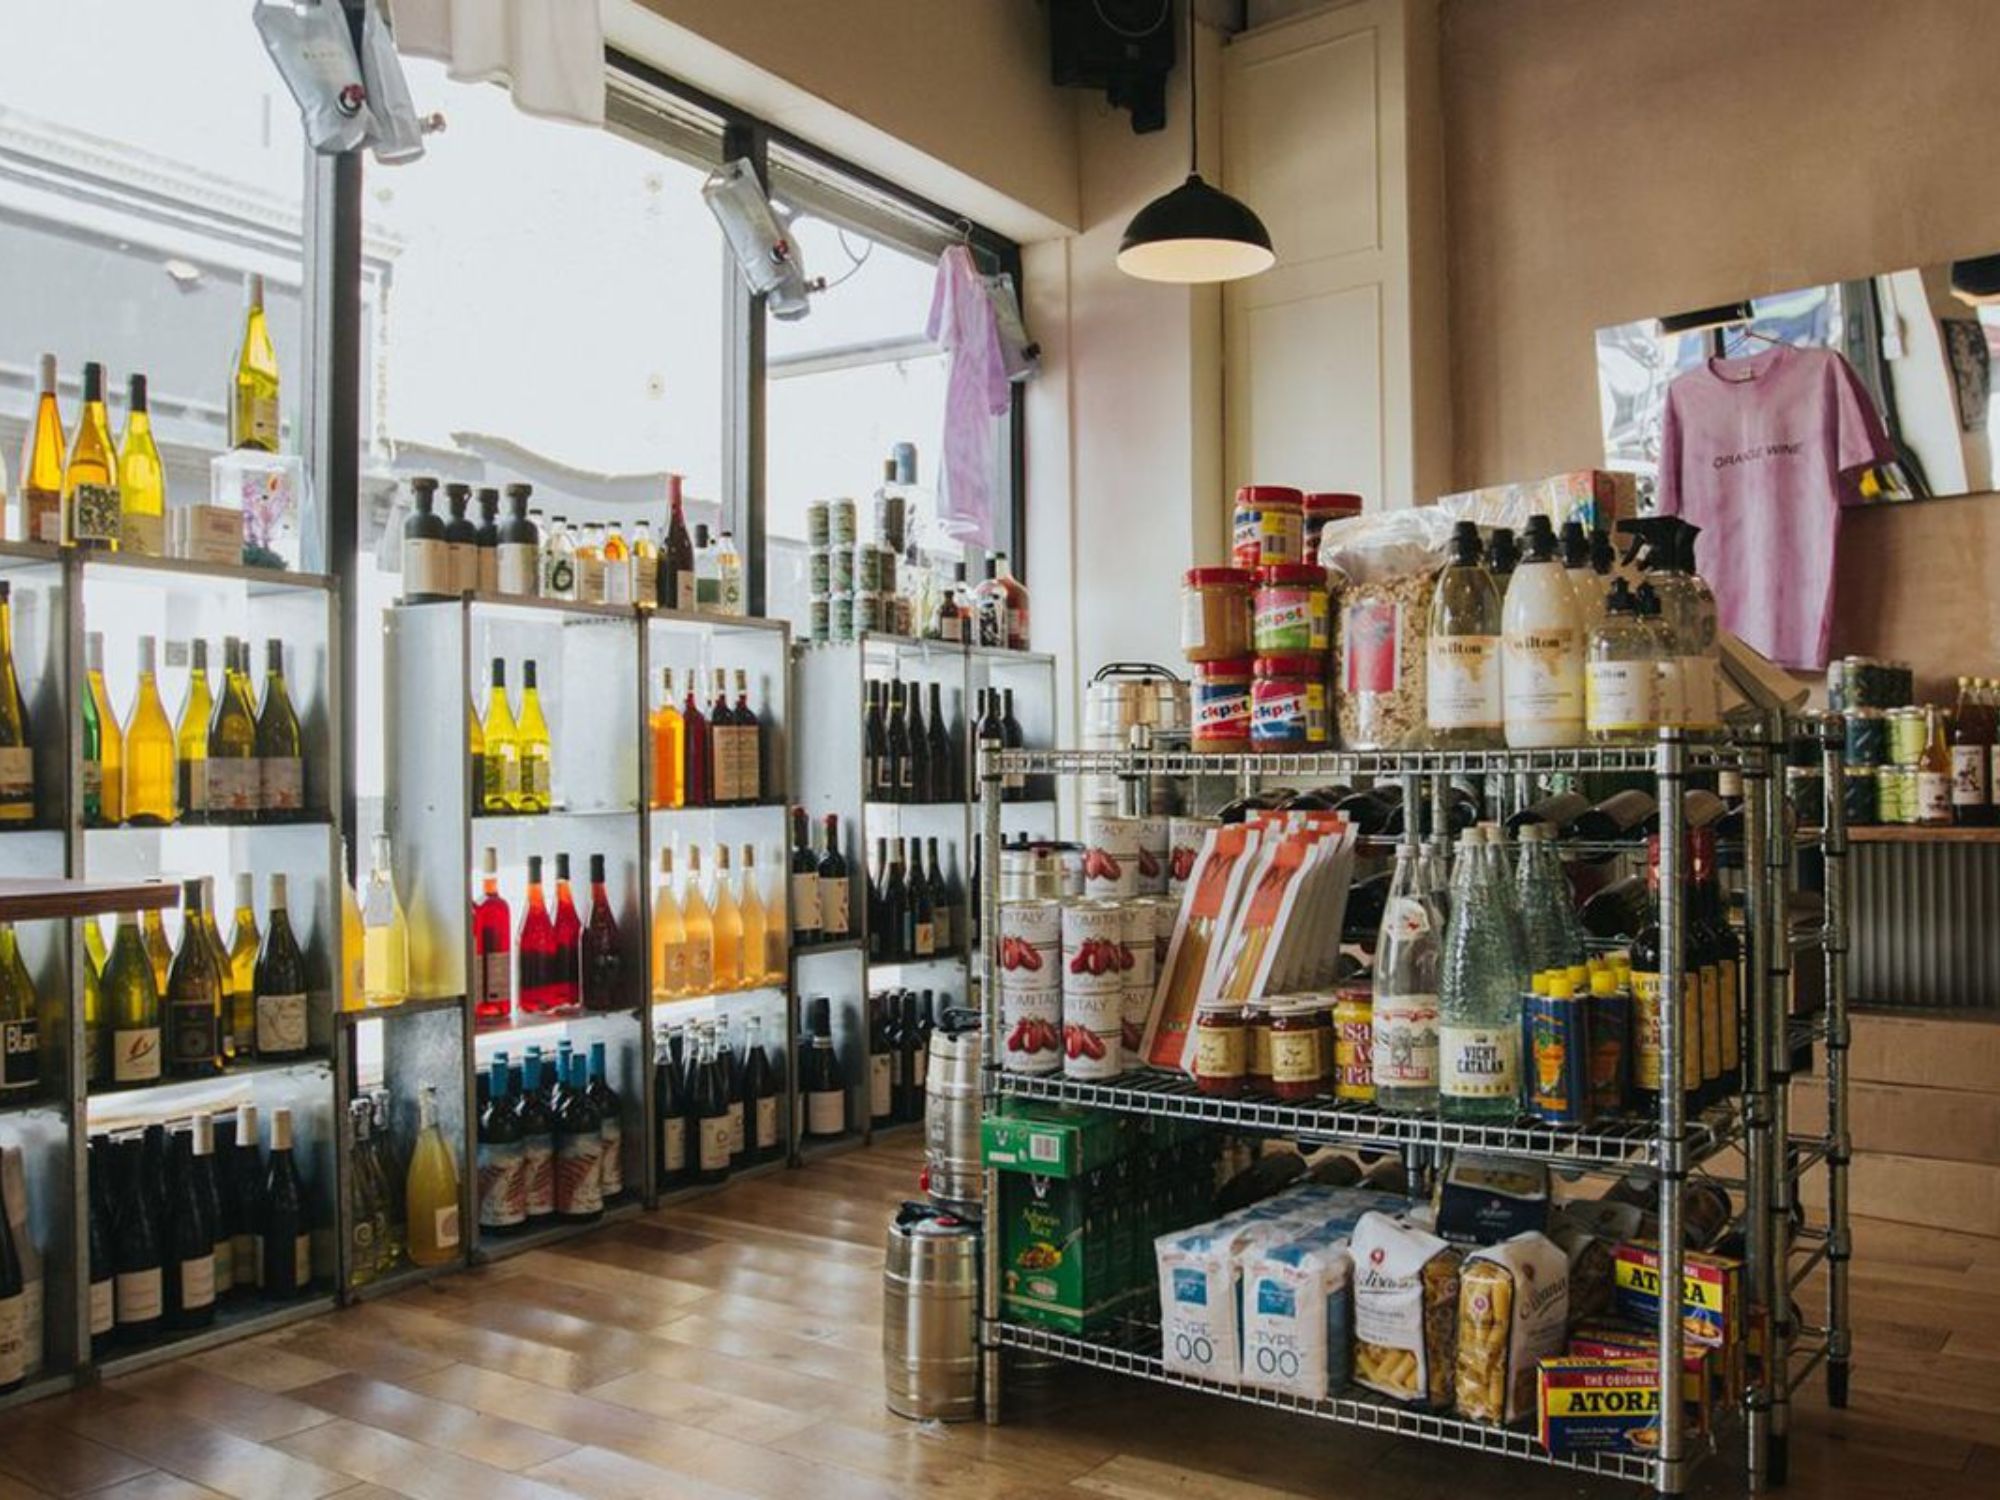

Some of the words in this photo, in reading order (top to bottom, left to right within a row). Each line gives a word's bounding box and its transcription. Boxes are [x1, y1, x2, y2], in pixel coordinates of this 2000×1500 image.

[1201, 701, 1250, 720] ckpot
[1254, 700, 1301, 719] ckpot
[1257, 1331, 1298, 1346] TYPE
[1584, 1374, 1603, 1386] THE
[1606, 1374, 1656, 1386] ORIGINAL
[1568, 1391, 1660, 1412] ATORA
